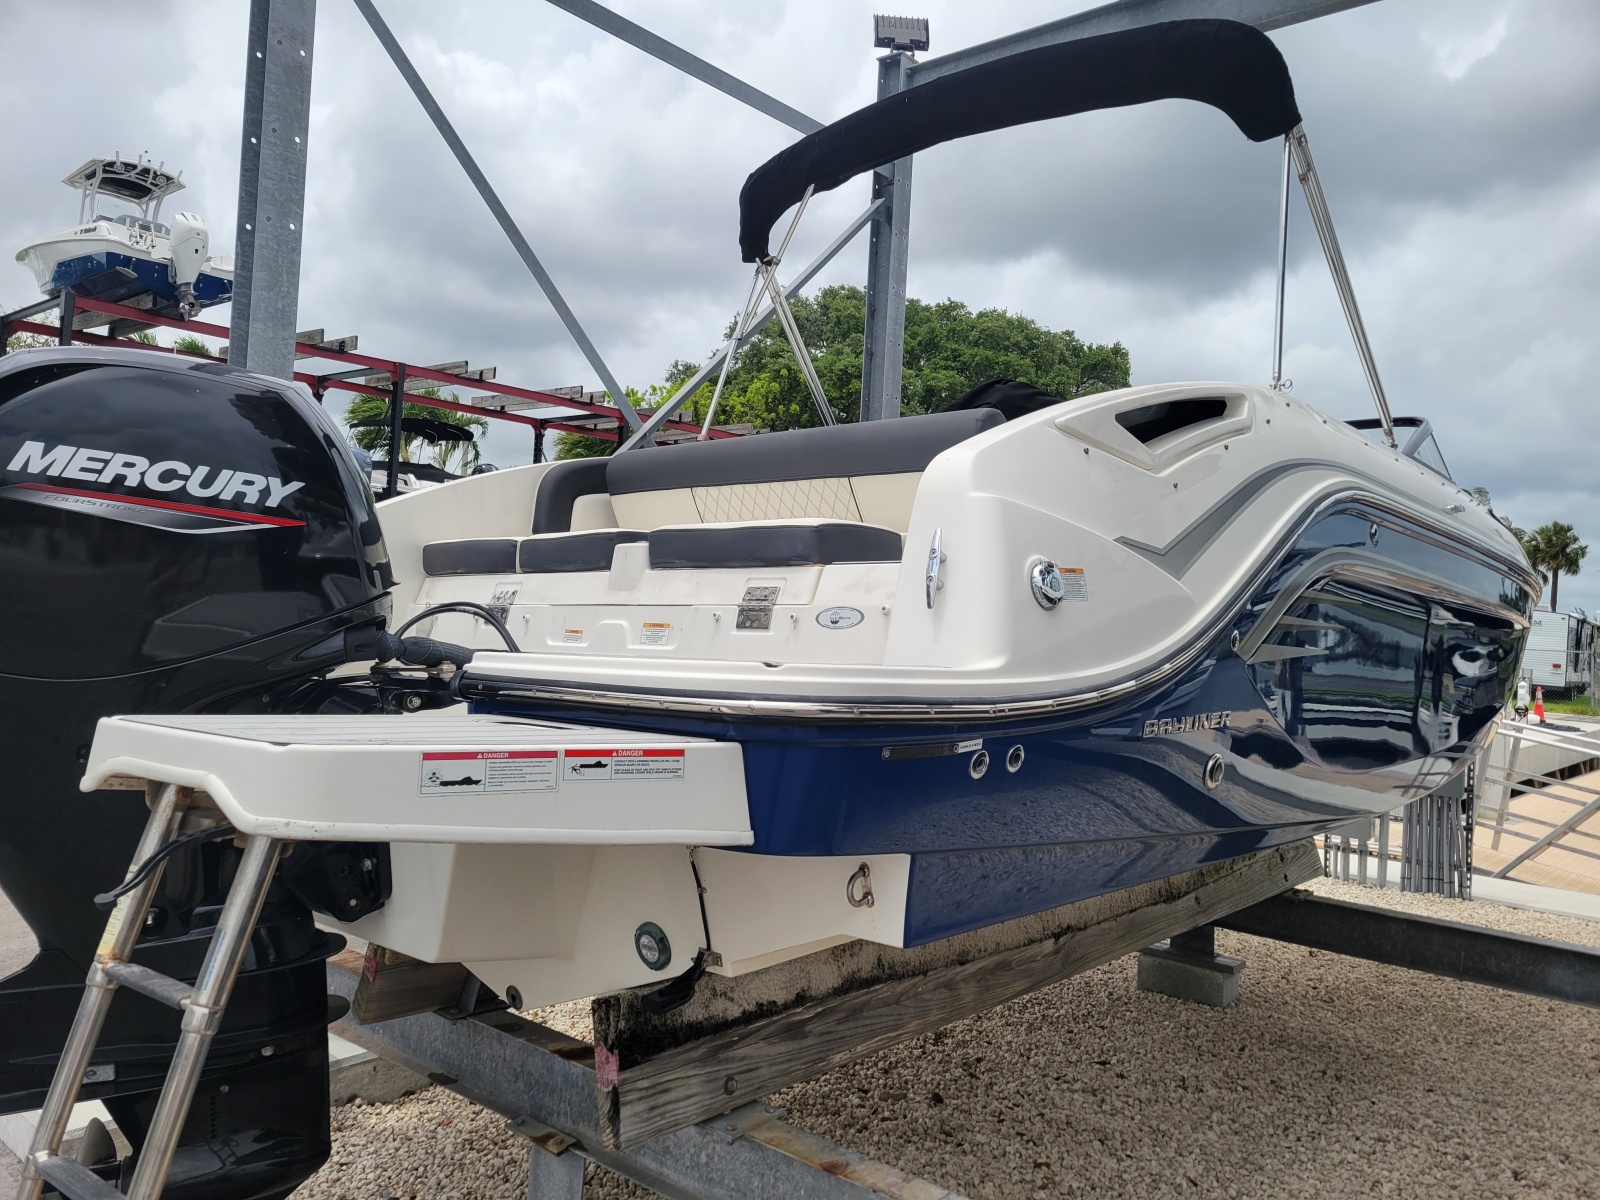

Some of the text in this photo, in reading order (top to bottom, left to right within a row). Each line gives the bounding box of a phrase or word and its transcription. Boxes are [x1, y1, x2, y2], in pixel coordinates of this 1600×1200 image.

[6, 440, 306, 508] MERCURY
[43, 494, 146, 514] FOURSTROKE
[1143, 711, 1232, 738] BAYLINER
